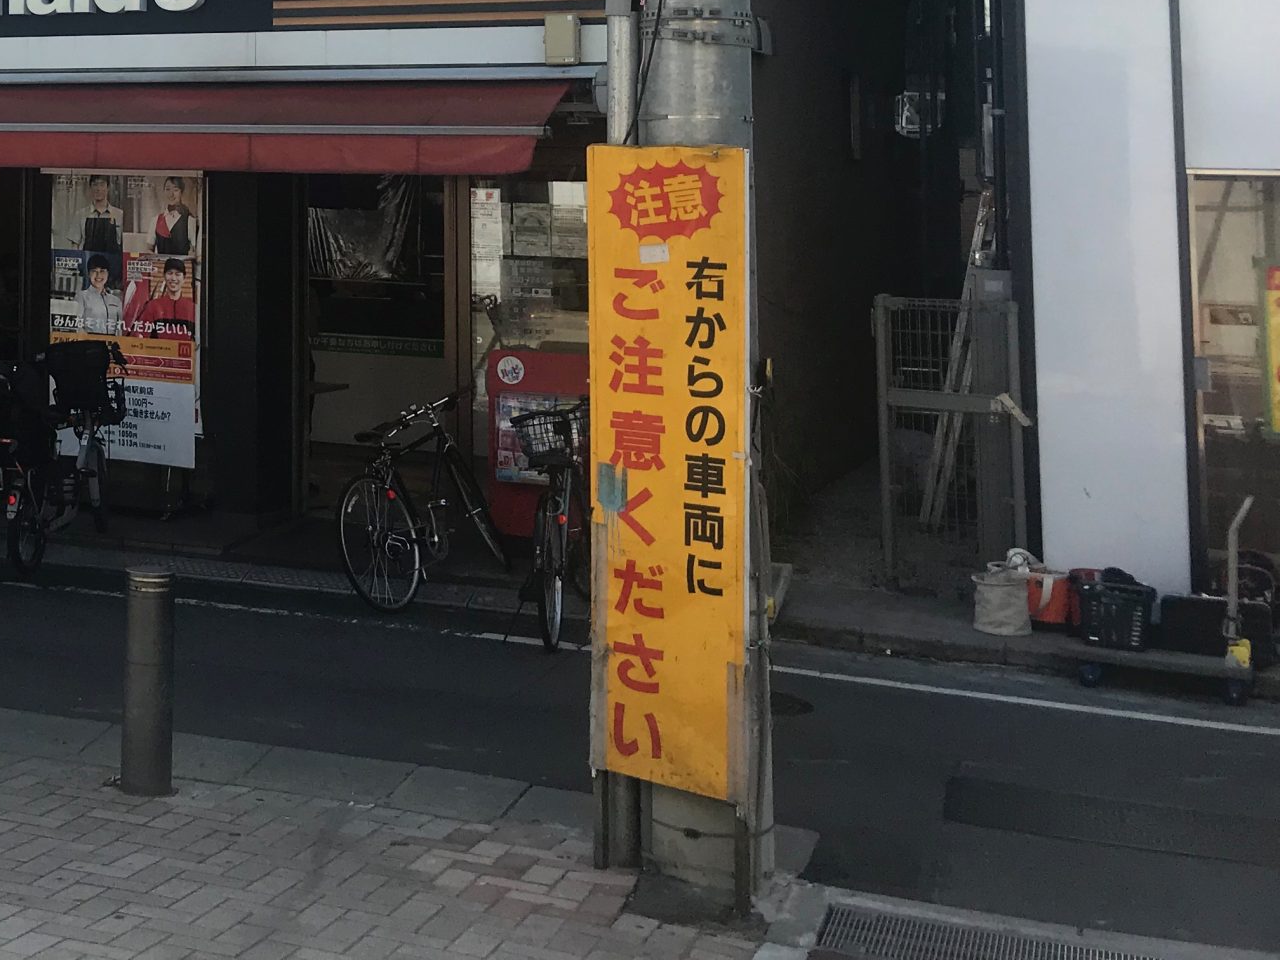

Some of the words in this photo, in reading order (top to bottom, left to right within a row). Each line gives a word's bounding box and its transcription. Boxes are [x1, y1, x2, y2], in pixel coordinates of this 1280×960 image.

[623, 173, 708, 227] 注意
[608, 267, 667, 760] ご注意ください
[683, 256, 728, 597] 右からの車両に
